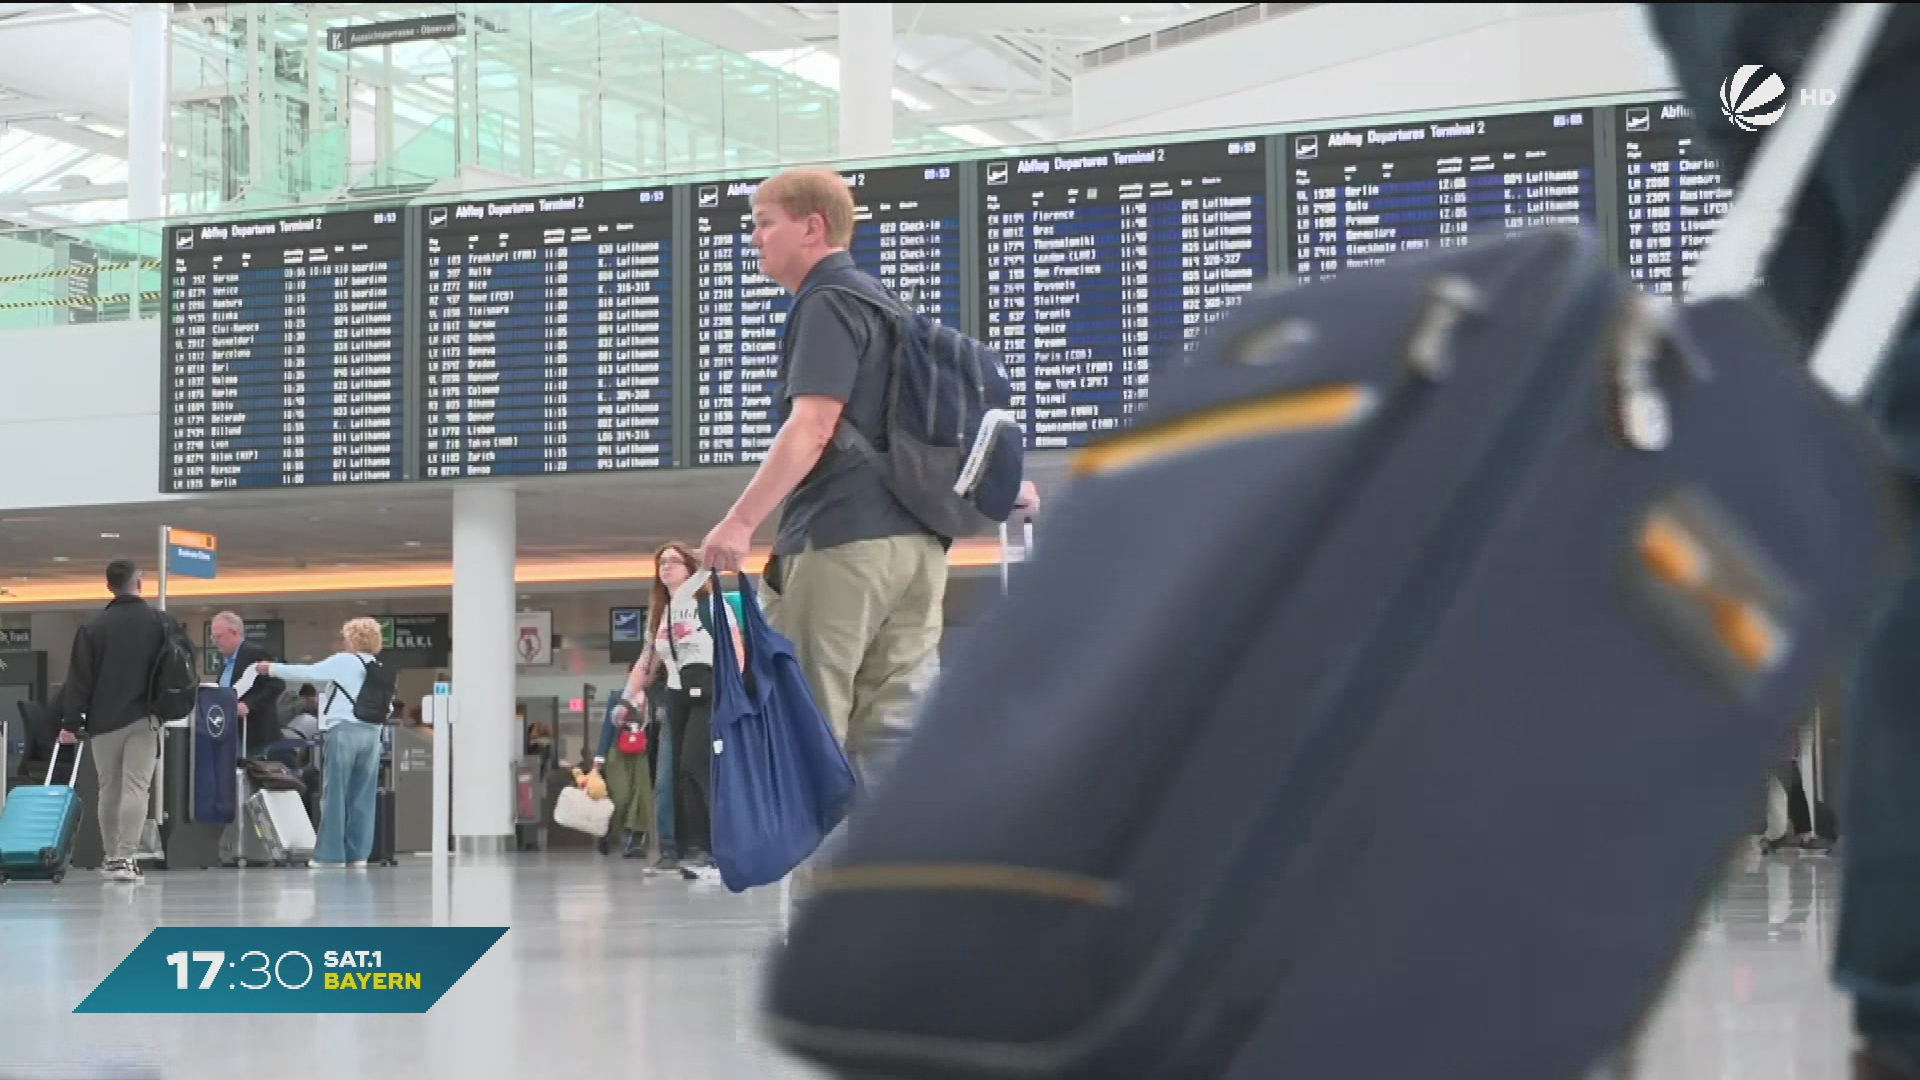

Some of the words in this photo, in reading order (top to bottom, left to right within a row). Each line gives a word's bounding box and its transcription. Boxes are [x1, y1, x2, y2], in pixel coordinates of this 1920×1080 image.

[1660, 105, 1695, 120] Abflu
[1328, 133, 1363, 148] Abflug
[1368, 129, 1425, 145] Departures
[1430, 123, 1475, 138] Terminal
[1478, 121, 1485, 135] 2
[1017, 160, 1050, 174] Abflug
[1054, 156, 1108, 171] Departures
[1113, 150, 1156, 165] Terminal
[1158, 149, 1165, 162] 2
[859, 174, 865, 186] 2
[1526, 169, 1578, 184] Lufthansa
[1526, 183, 1579, 199] Lufthansa
[455, 205, 484, 219] Abflug
[488, 203, 535, 217] Departures
[539, 197, 576, 211] Terminal
[578, 197, 584, 209] 2
[1202, 195, 1251, 210] Lufthansa
[1527, 198, 1579, 213] Lufthansa
[1202, 209, 1251, 224] Lufthansa
[201, 227, 228, 240] Abflug
[232, 223, 276, 237] Departures
[279, 219, 314, 233] Terminal
[316, 218, 322, 230] 2
[1202, 223, 1251, 238] Lufthansa
[616, 240, 658, 254] Lufthansa
[1203, 238, 1251, 252] Lufthansa
[616, 254, 658, 267] Lufthansa
[616, 267, 658, 280] Lufthansa
[1203, 266, 1252, 281] Lufthansa
[616, 294, 658, 307] Lufthansa
[350, 312, 390, 325] Lufthansa
[616, 308, 658, 321] Lufthansa
[350, 325, 390, 338] Lufthansa
[350, 338, 390, 351] Lufthansa
[350, 351, 390, 364] Lufthansa
[350, 364, 390, 377] Lufthansa
[350, 377, 390, 390] Lufthansa
